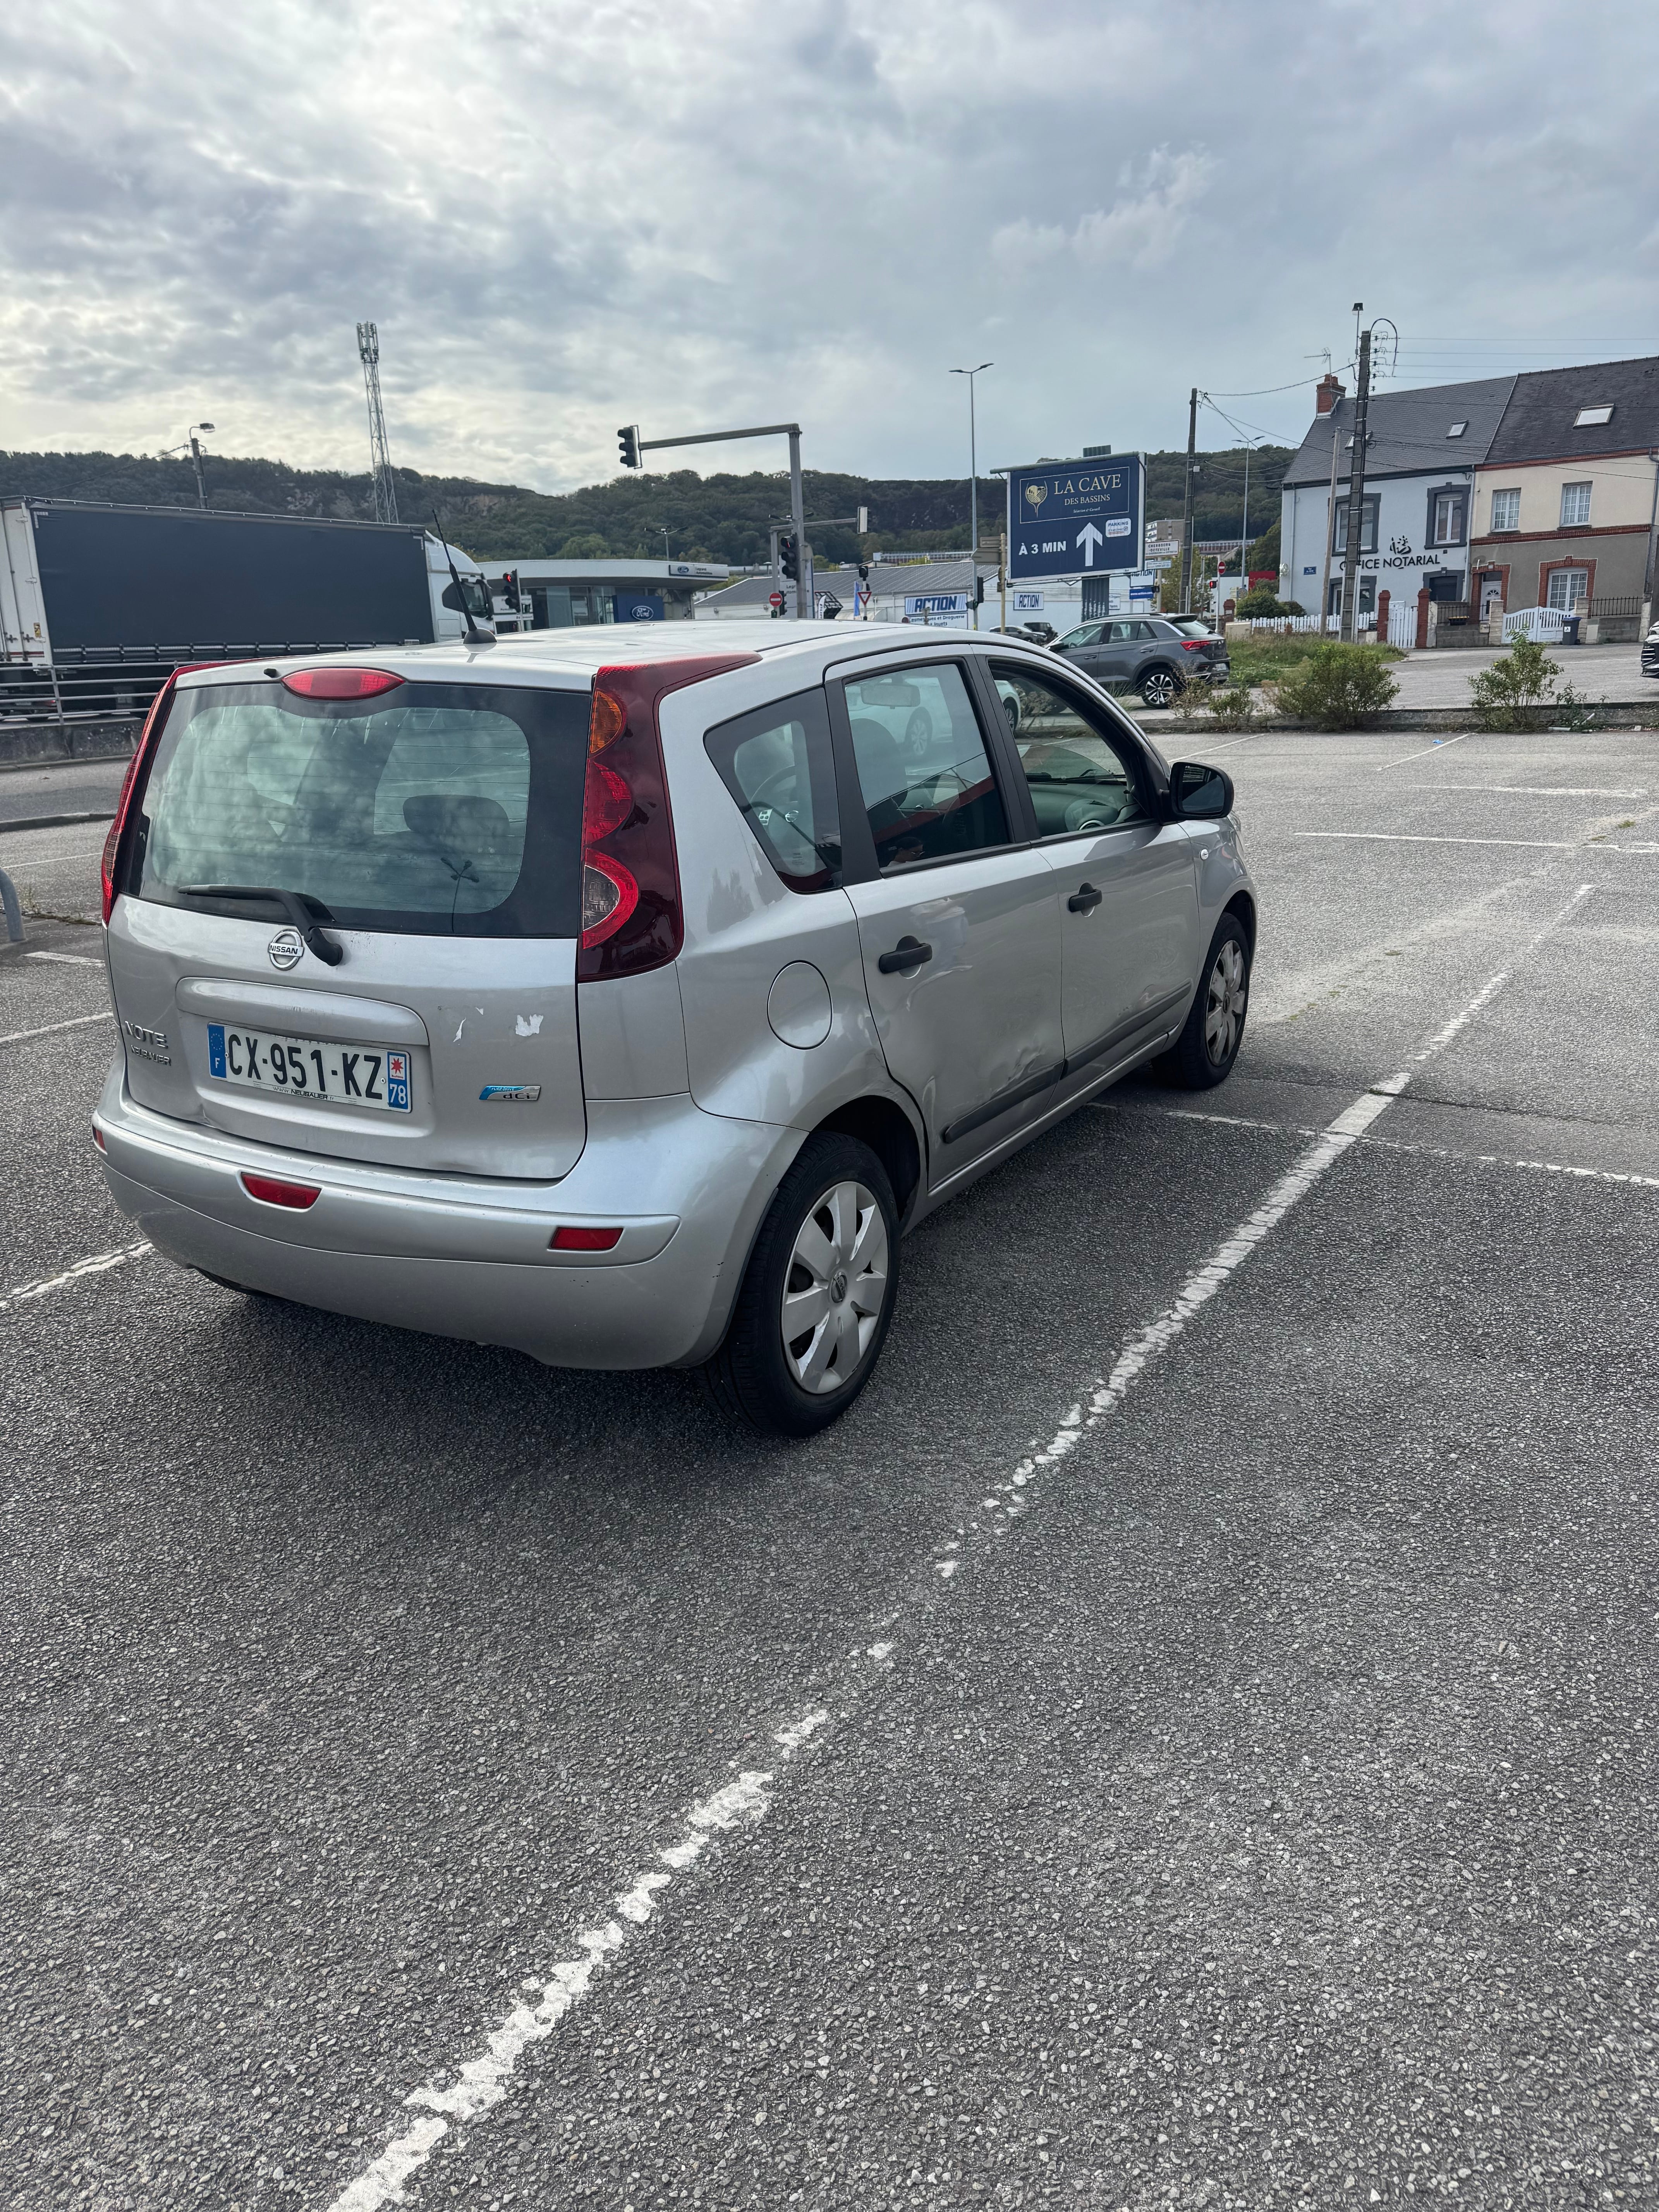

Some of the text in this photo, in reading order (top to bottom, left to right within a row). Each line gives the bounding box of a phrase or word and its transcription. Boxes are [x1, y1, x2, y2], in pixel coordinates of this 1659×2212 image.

[1054, 474, 1121, 495] LA CAVE
[1065, 494, 1110, 505] DES BASSINS
[1018, 541, 1066, 555] À 3 MIN
[1383, 554, 1440, 568] NOTARIAL
[914, 596, 957, 613] ACTION
[1019, 594, 1039, 608] ACTION
[270, 945, 298, 955] NISSAN
[125, 1020, 168, 1049] NOTE
[215, 1058, 220, 1068] F
[228, 1034, 383, 1100] CX-951-KZ
[390, 1084, 406, 1104] 78
